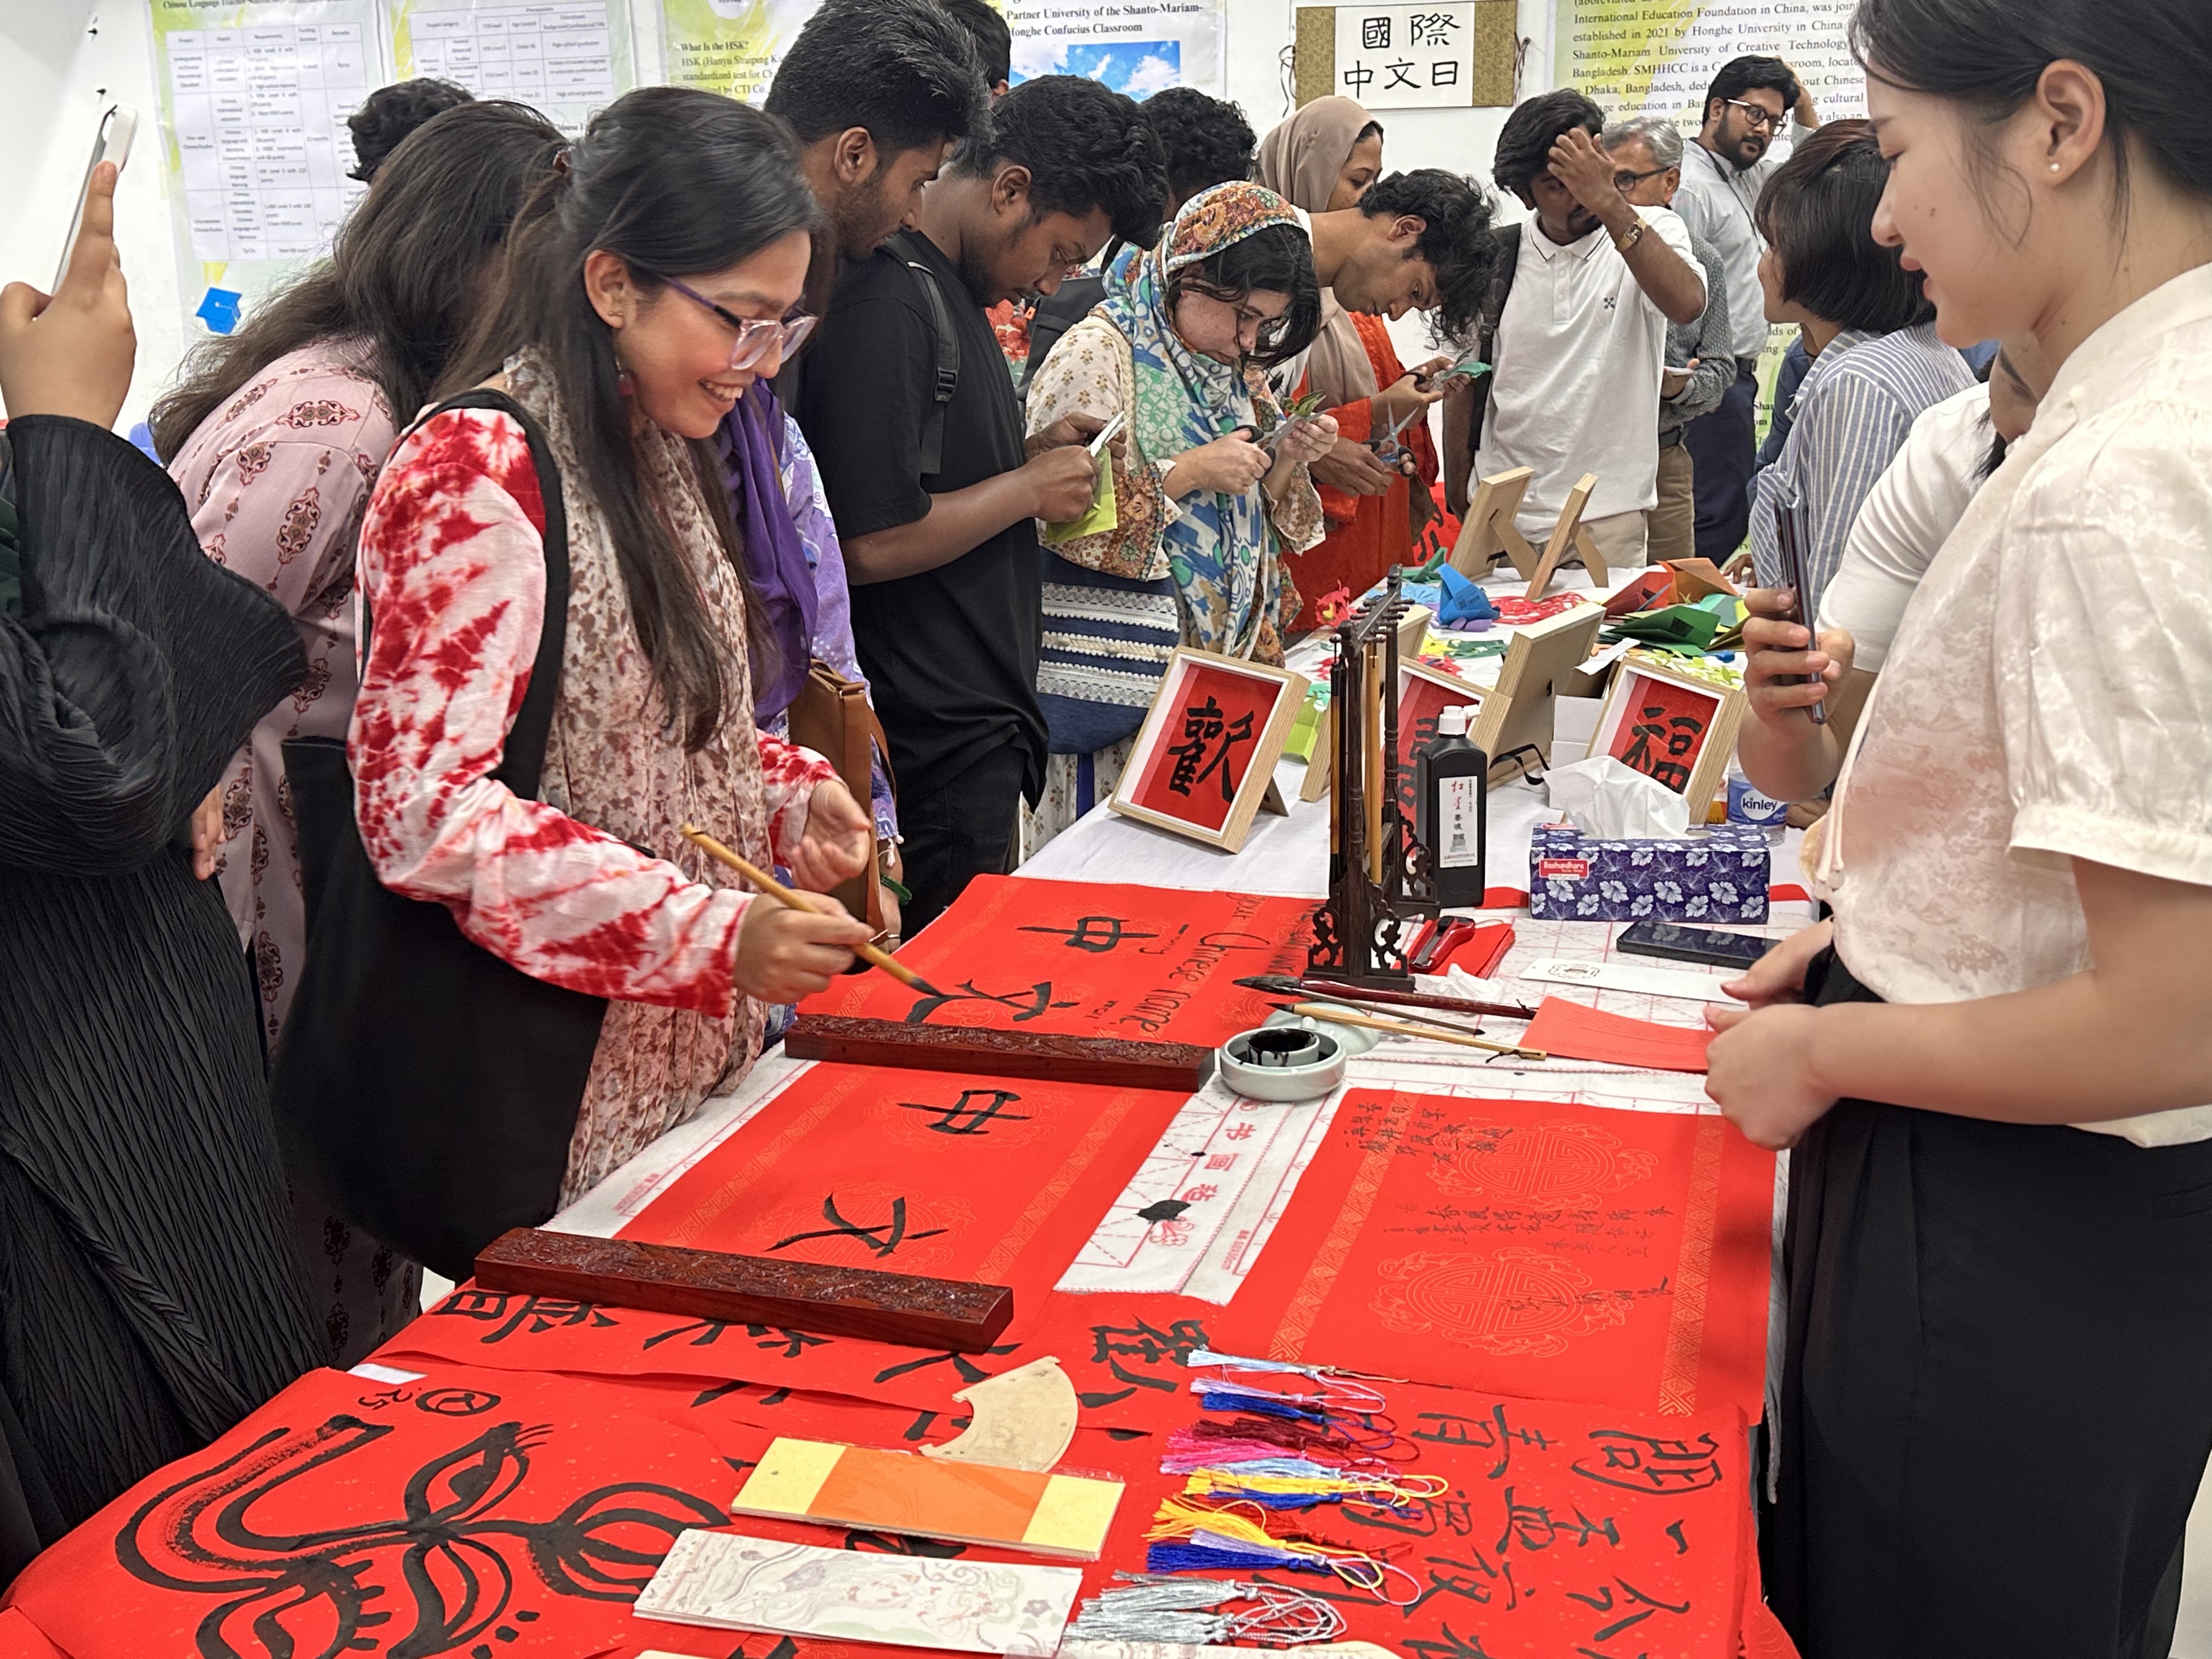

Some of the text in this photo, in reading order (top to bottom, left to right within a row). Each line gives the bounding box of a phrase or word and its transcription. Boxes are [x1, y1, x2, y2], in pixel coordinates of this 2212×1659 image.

[1007, 2, 1204, 20] Partner University of the Shanto-Mariam-
[1574, 11, 1639, 24] International
[1641, 9, 1693, 21] Education
[1697, 6, 1757, 18] Foundation
[1774, 3, 1809, 14] China,
[1813, 3, 1832, 12] was
[1044, 23, 1091, 36] Confucius
[1092, 22, 1143, 34] Classroom
[1362, 13, 1461, 49] 國際
[1573, 20, 1843, 42] established in 2021 by Honghe University in China
[680, 41, 749, 52] What Is the HSK?
[1572, 47, 1651, 60] Shanto-Mariam
[1659, 45, 1711, 56] University
[1718, 43, 1730, 53] of
[1736, 42, 1781, 53] Creative
[681, 57, 701, 66] HSK
[1634, 63, 1689, 75] SMHHCC
[1691, 62, 1699, 73] is
[1702, 64, 1708, 72] a
[682, 71, 731, 81] standardized
[733, 71, 748, 80] test
[748, 70, 760, 79] for
[1344, 57, 1460, 99] 中文日
[734, 84, 751, 94] CTI
[1585, 84, 1621, 95] Dhaka,
[1626, 81, 1685, 94] Bangladesh,
[1824, 75, 1865, 86] Chinese
[1618, 101, 1667, 111] education
[1672, 101, 1682, 110] in
[1823, 92, 1864, 104] cultural
[1742, 797, 1778, 812] kinley
[1168, 932, 1271, 983] Chinese
